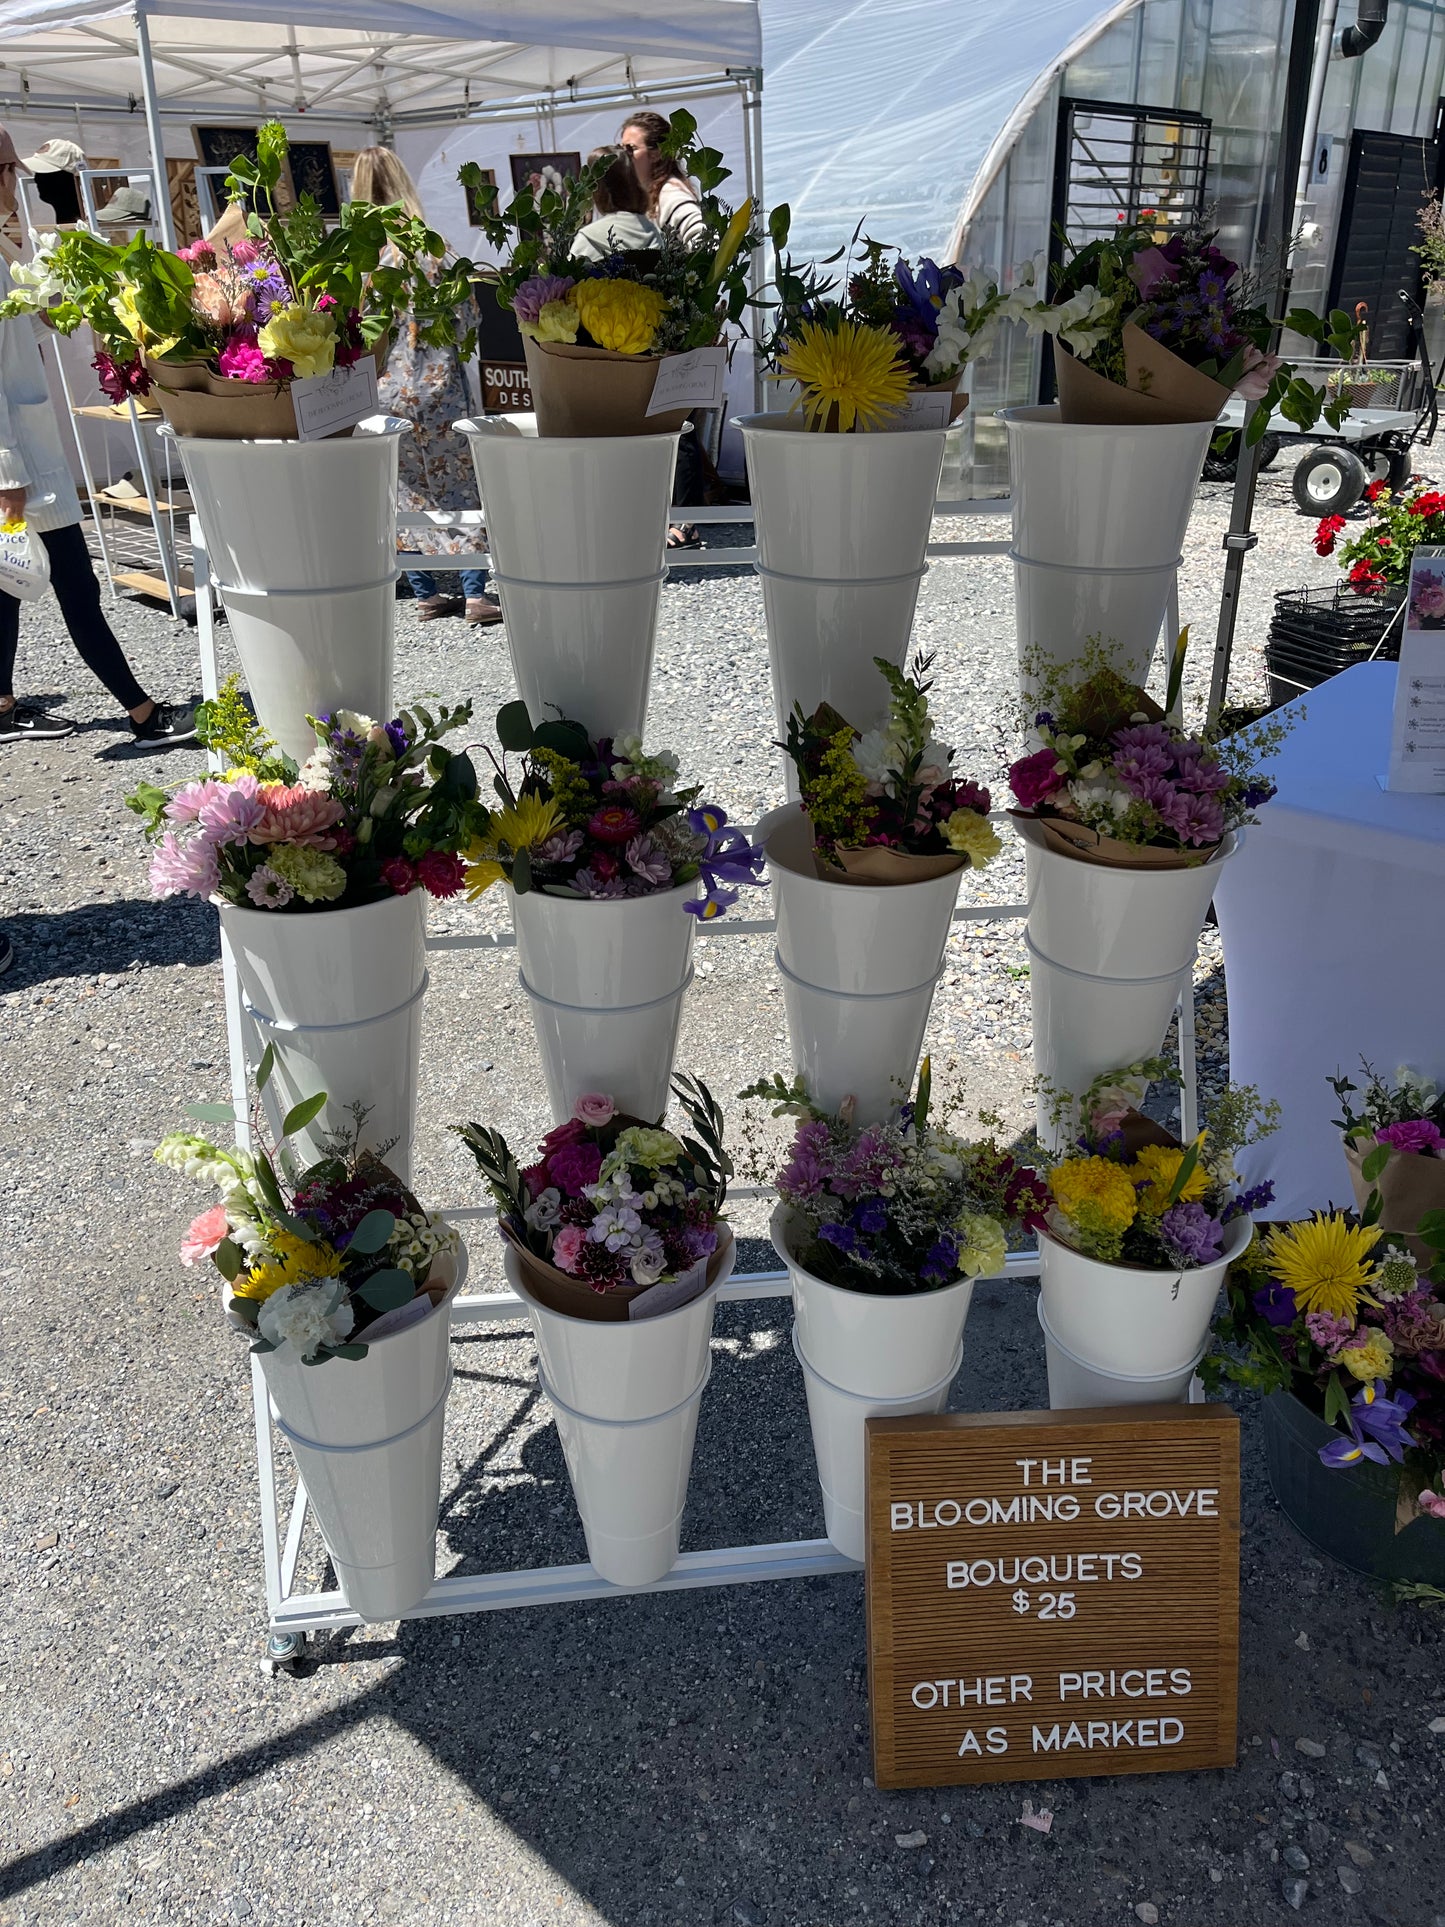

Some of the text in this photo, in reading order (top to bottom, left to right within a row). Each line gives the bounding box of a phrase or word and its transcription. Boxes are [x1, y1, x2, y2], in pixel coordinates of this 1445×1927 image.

[1319, 148, 1328, 175] 8
[485, 367, 531, 389] SOUTH
[500, 391, 531, 407] DES
[4, 550, 31, 570] You!
[1015, 1457, 1093, 1487] THE
[890, 1488, 1219, 1532] BLOOMING GROVE
[946, 1552, 1143, 1589] BOUQUETS
[1012, 1588, 1077, 1620] $ 25
[911, 1668, 1192, 1709] OTHER PRICES
[958, 1717, 1184, 1757] AS MARKED
